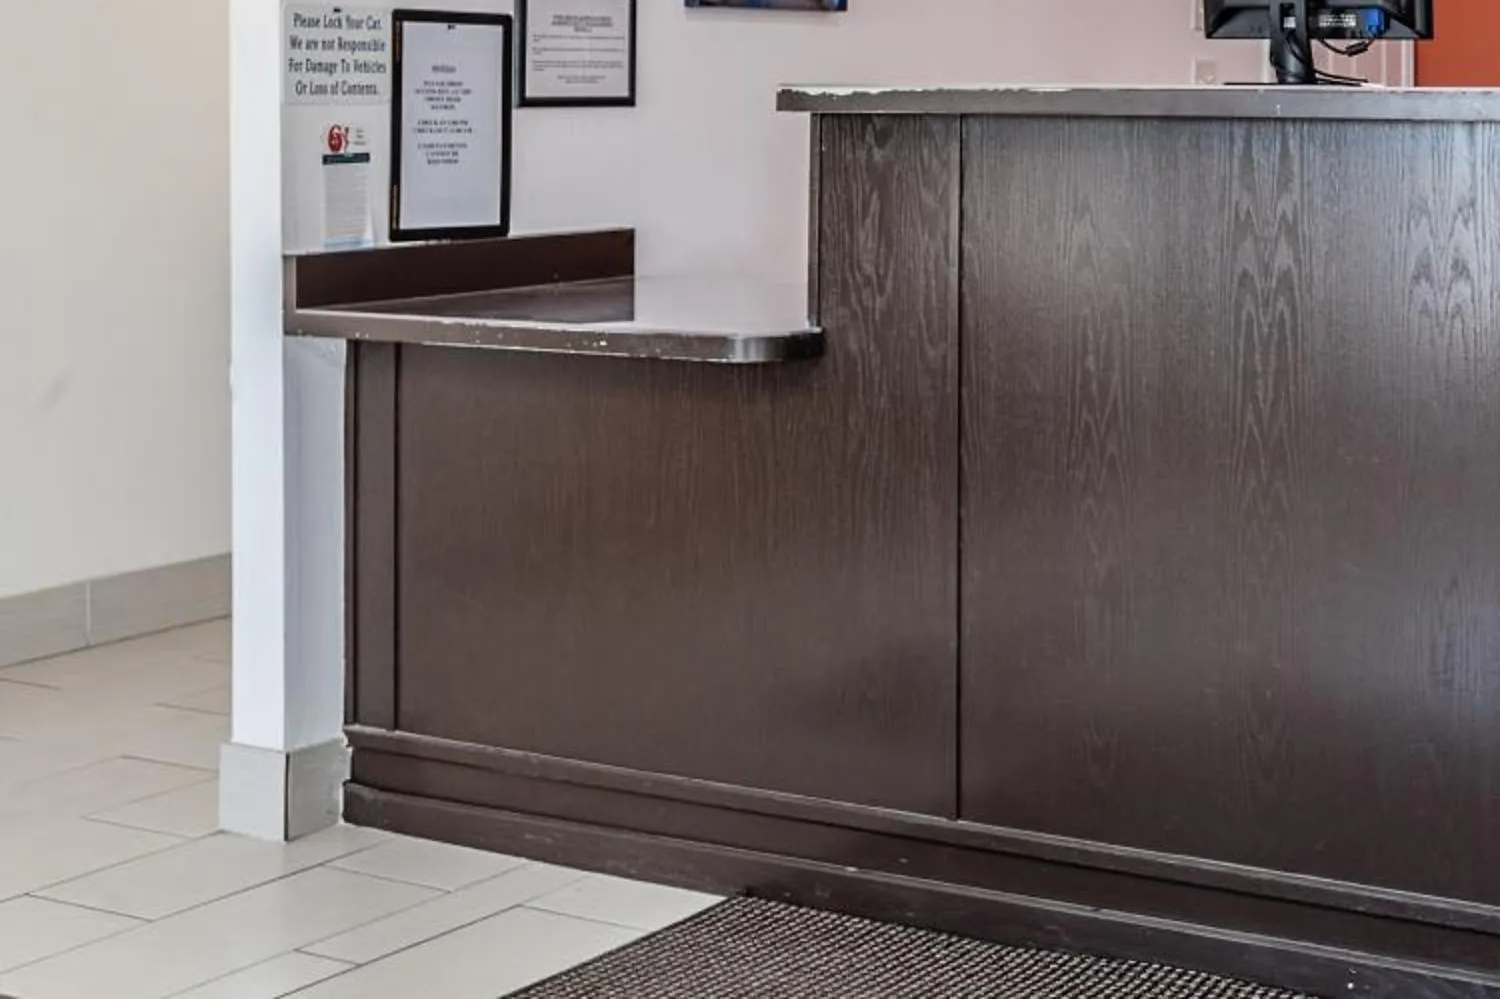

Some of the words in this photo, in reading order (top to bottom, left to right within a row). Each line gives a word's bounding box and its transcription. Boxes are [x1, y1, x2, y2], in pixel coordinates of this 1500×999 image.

[293, 12, 320, 28] Please
[323, 13, 342, 29] Lock
[345, 14, 364, 30] Your
[289, 34, 303, 50] We
[305, 39, 319, 51] are
[321, 38, 336, 51] not
[337, 36, 386, 55] Responsible
[288, 57, 303, 73] For
[305, 58, 338, 77] Damage
[340, 58, 351, 74] To
[353, 59, 387, 74] Vehicles
[295, 79, 308, 96] Or
[309, 80, 329, 96] Loss
[330, 80, 339, 96] of
